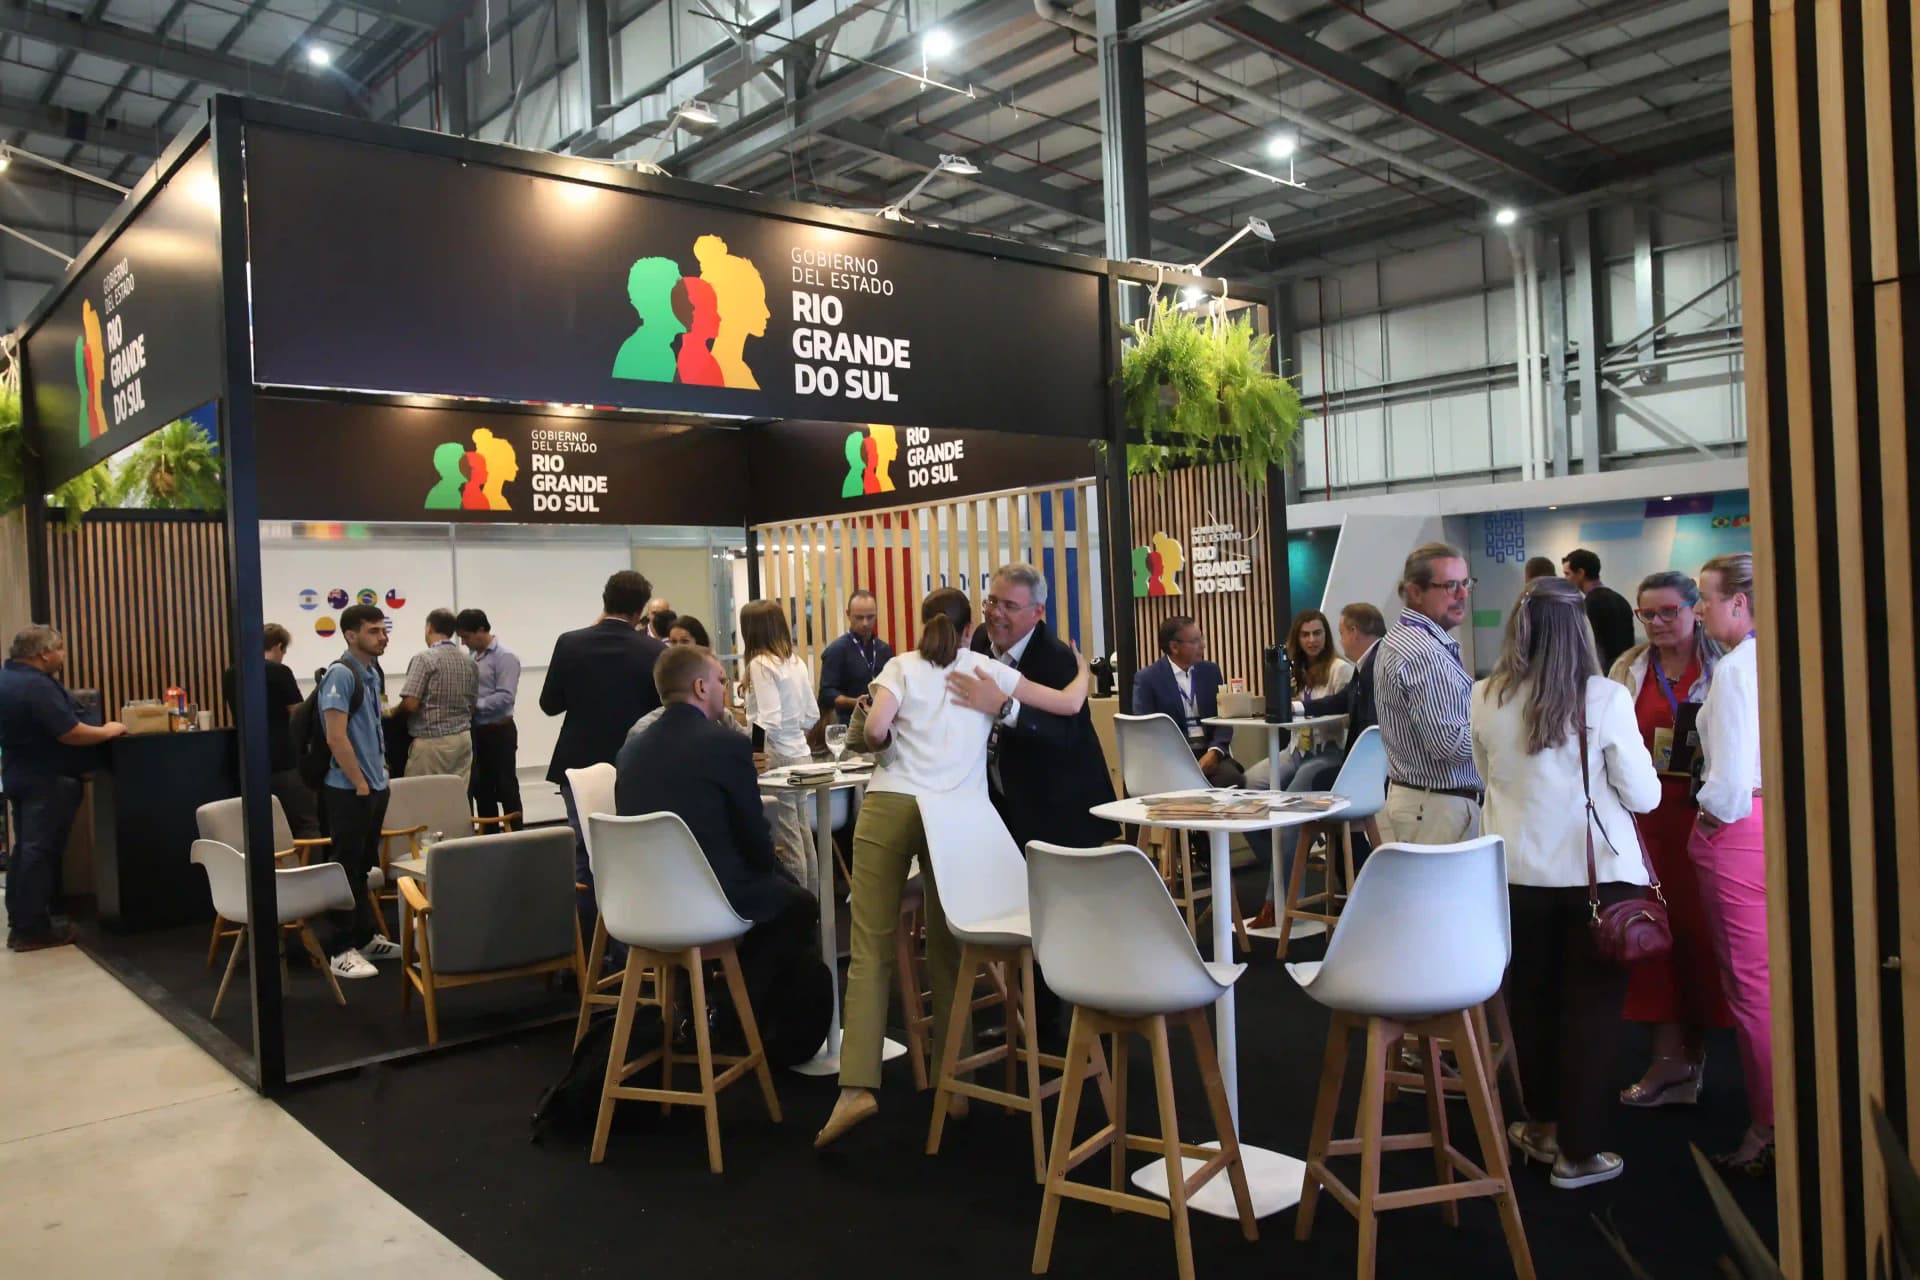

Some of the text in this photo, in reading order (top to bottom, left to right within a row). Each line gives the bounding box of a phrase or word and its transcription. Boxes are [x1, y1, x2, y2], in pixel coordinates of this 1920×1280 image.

[791, 247, 878, 275] GOBIERNO
[103, 256, 129, 295] GOBIERNO
[792, 266, 894, 296] DEL ESTADO
[105, 273, 135, 315] DEL ESTADO
[792, 290, 843, 326] RIO
[107, 314, 123, 352] RIO
[110, 333, 146, 389] GRANDE
[792, 328, 911, 368] GRANDE
[794, 363, 899, 402] DO SUL
[113, 377, 145, 425] DO SUL
[531, 430, 587, 442] GOBIERNO
[531, 440, 597, 453] DEL ESTADO
[906, 426, 930, 446] RIO
[532, 454, 564, 472] RIO
[907, 439, 964, 467] GRANDE
[532, 474, 608, 493] GRANDE
[908, 463, 958, 488] DO SUL
[533, 494, 600, 512] DO SUL
[1191, 546, 1218, 561] RIO
[1192, 560, 1252, 577] GRANDE
[1194, 577, 1246, 594] DO SUL
